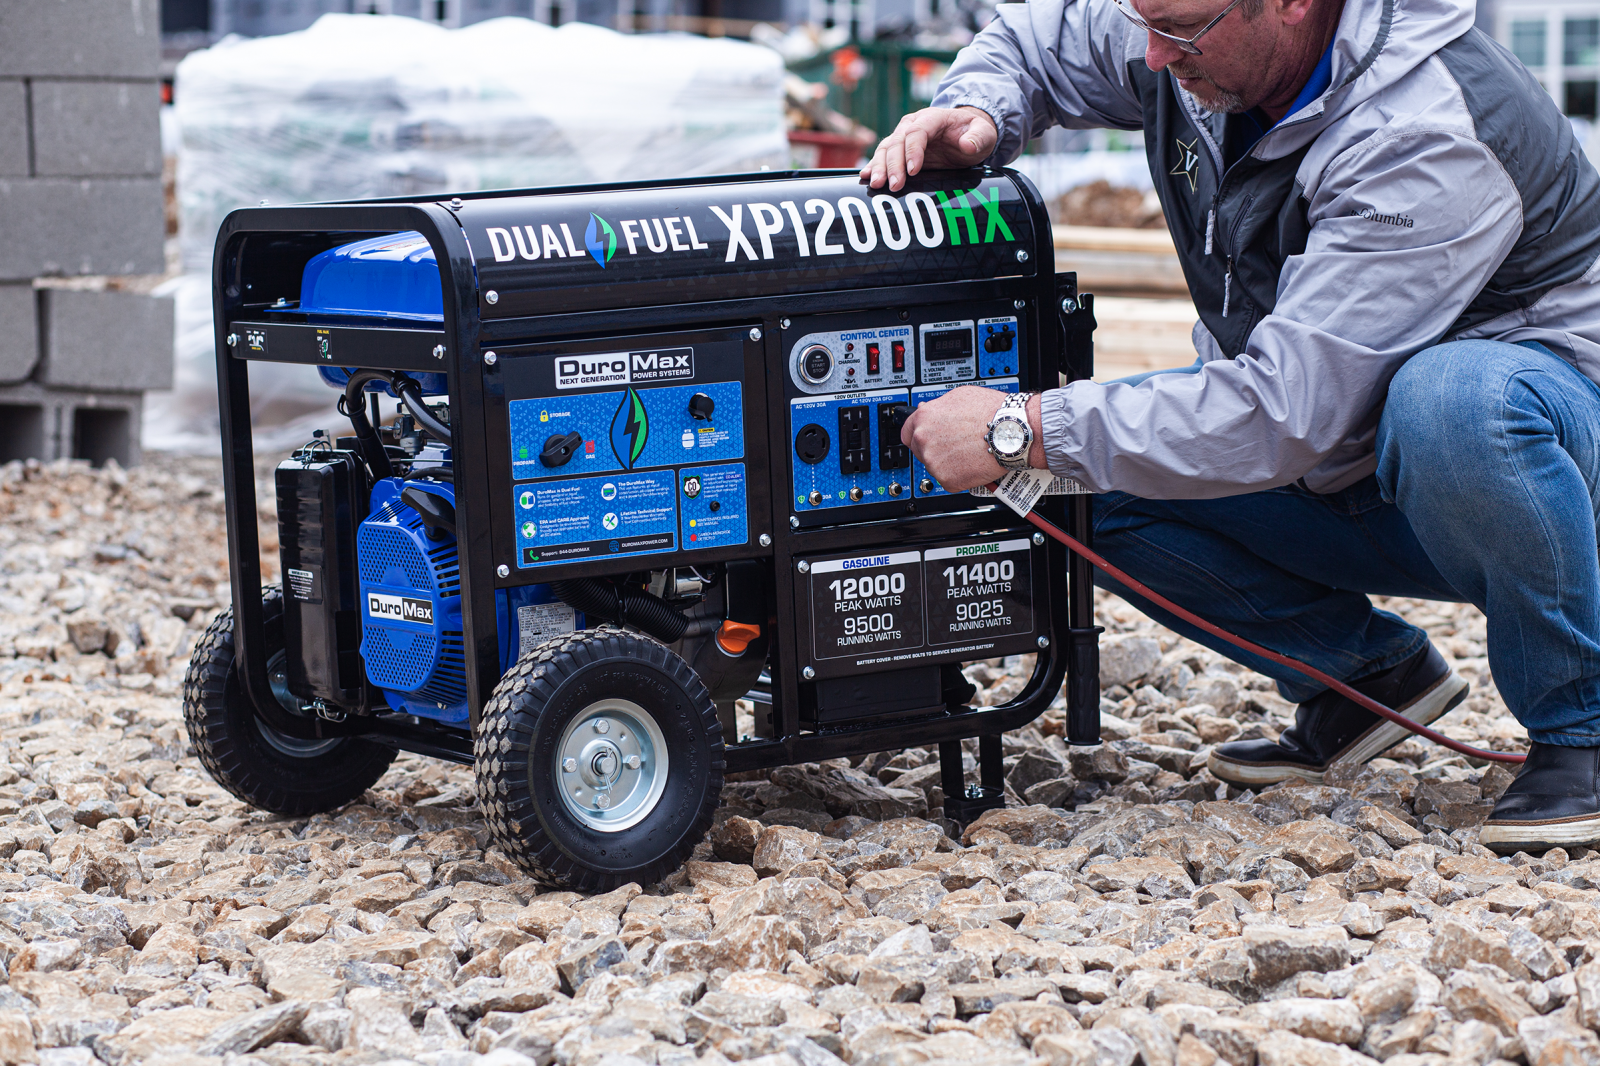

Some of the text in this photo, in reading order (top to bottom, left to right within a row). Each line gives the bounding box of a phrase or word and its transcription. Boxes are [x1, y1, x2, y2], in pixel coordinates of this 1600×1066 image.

[1186, 150, 1198, 172] V
[486, 187, 1016, 263] DUAL FUEL XP12000HX
[1360, 208, 1414, 228] Columbia
[840, 329, 909, 341] CONTROL CENTER
[581, 374, 626, 383] GENERATION
[956, 544, 1000, 556] PROPANE
[842, 556, 890, 569] GASOLINE
[942, 560, 1015, 586] 11400
[828, 573, 905, 600] 12000
[947, 582, 1012, 599] PEAK WATTS
[834, 595, 901, 612] PEAK WATTS
[956, 600, 1004, 621] 9025
[844, 613, 893, 635] 9500
[950, 617, 1012, 632] RUNNING WATTS
[837, 631, 901, 646] RUNNING WATTS
[951, 645, 976, 654] GENERATOR
